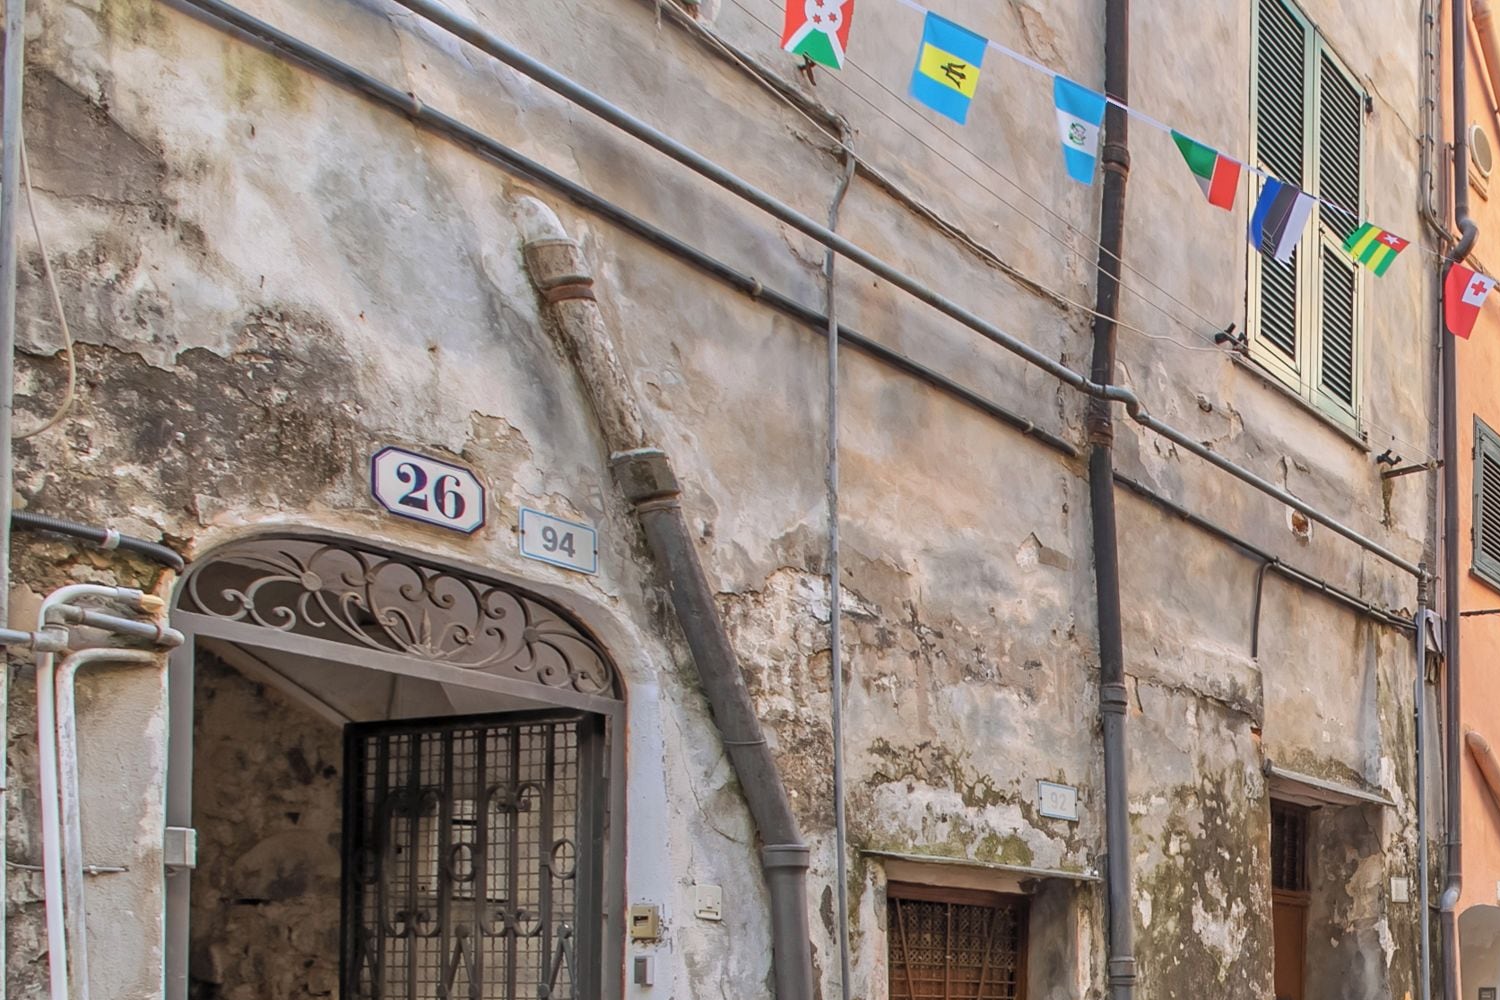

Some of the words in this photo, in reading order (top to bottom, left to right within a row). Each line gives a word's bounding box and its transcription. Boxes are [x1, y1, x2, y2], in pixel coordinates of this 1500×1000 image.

[396, 462, 466, 520] 26
[541, 525, 576, 558] 94
[1050, 791, 1067, 812] 92
